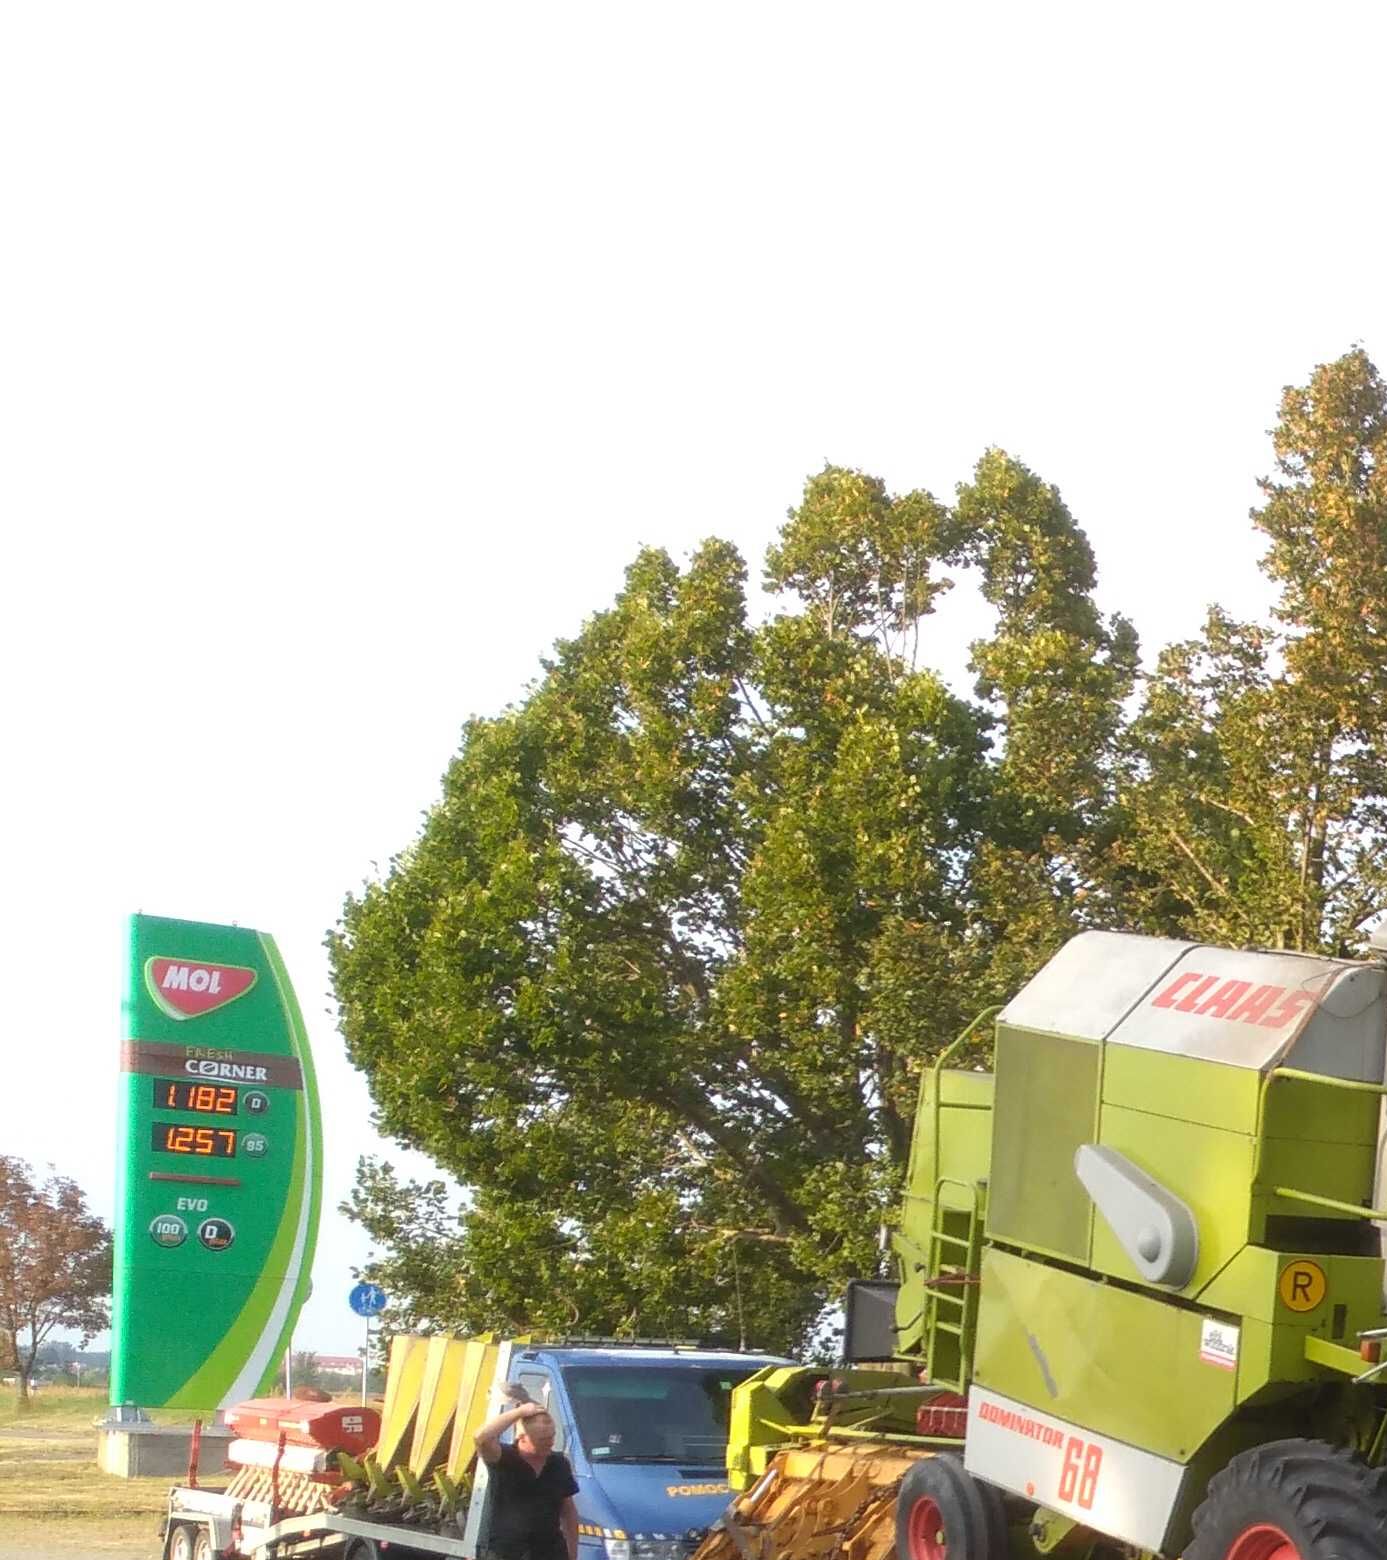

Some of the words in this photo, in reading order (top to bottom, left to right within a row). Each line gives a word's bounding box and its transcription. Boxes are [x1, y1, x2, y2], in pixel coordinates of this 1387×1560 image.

[162, 965, 221, 994] MOL
[1151, 972, 1321, 1029] CLAAS
[177, 1197, 208, 1211] EVO
[205, 1225, 218, 1239] D
[1292, 1271, 1313, 1302] R
[979, 1401, 1064, 1449] DOMINATOR
[1058, 1437, 1104, 1510] 68
